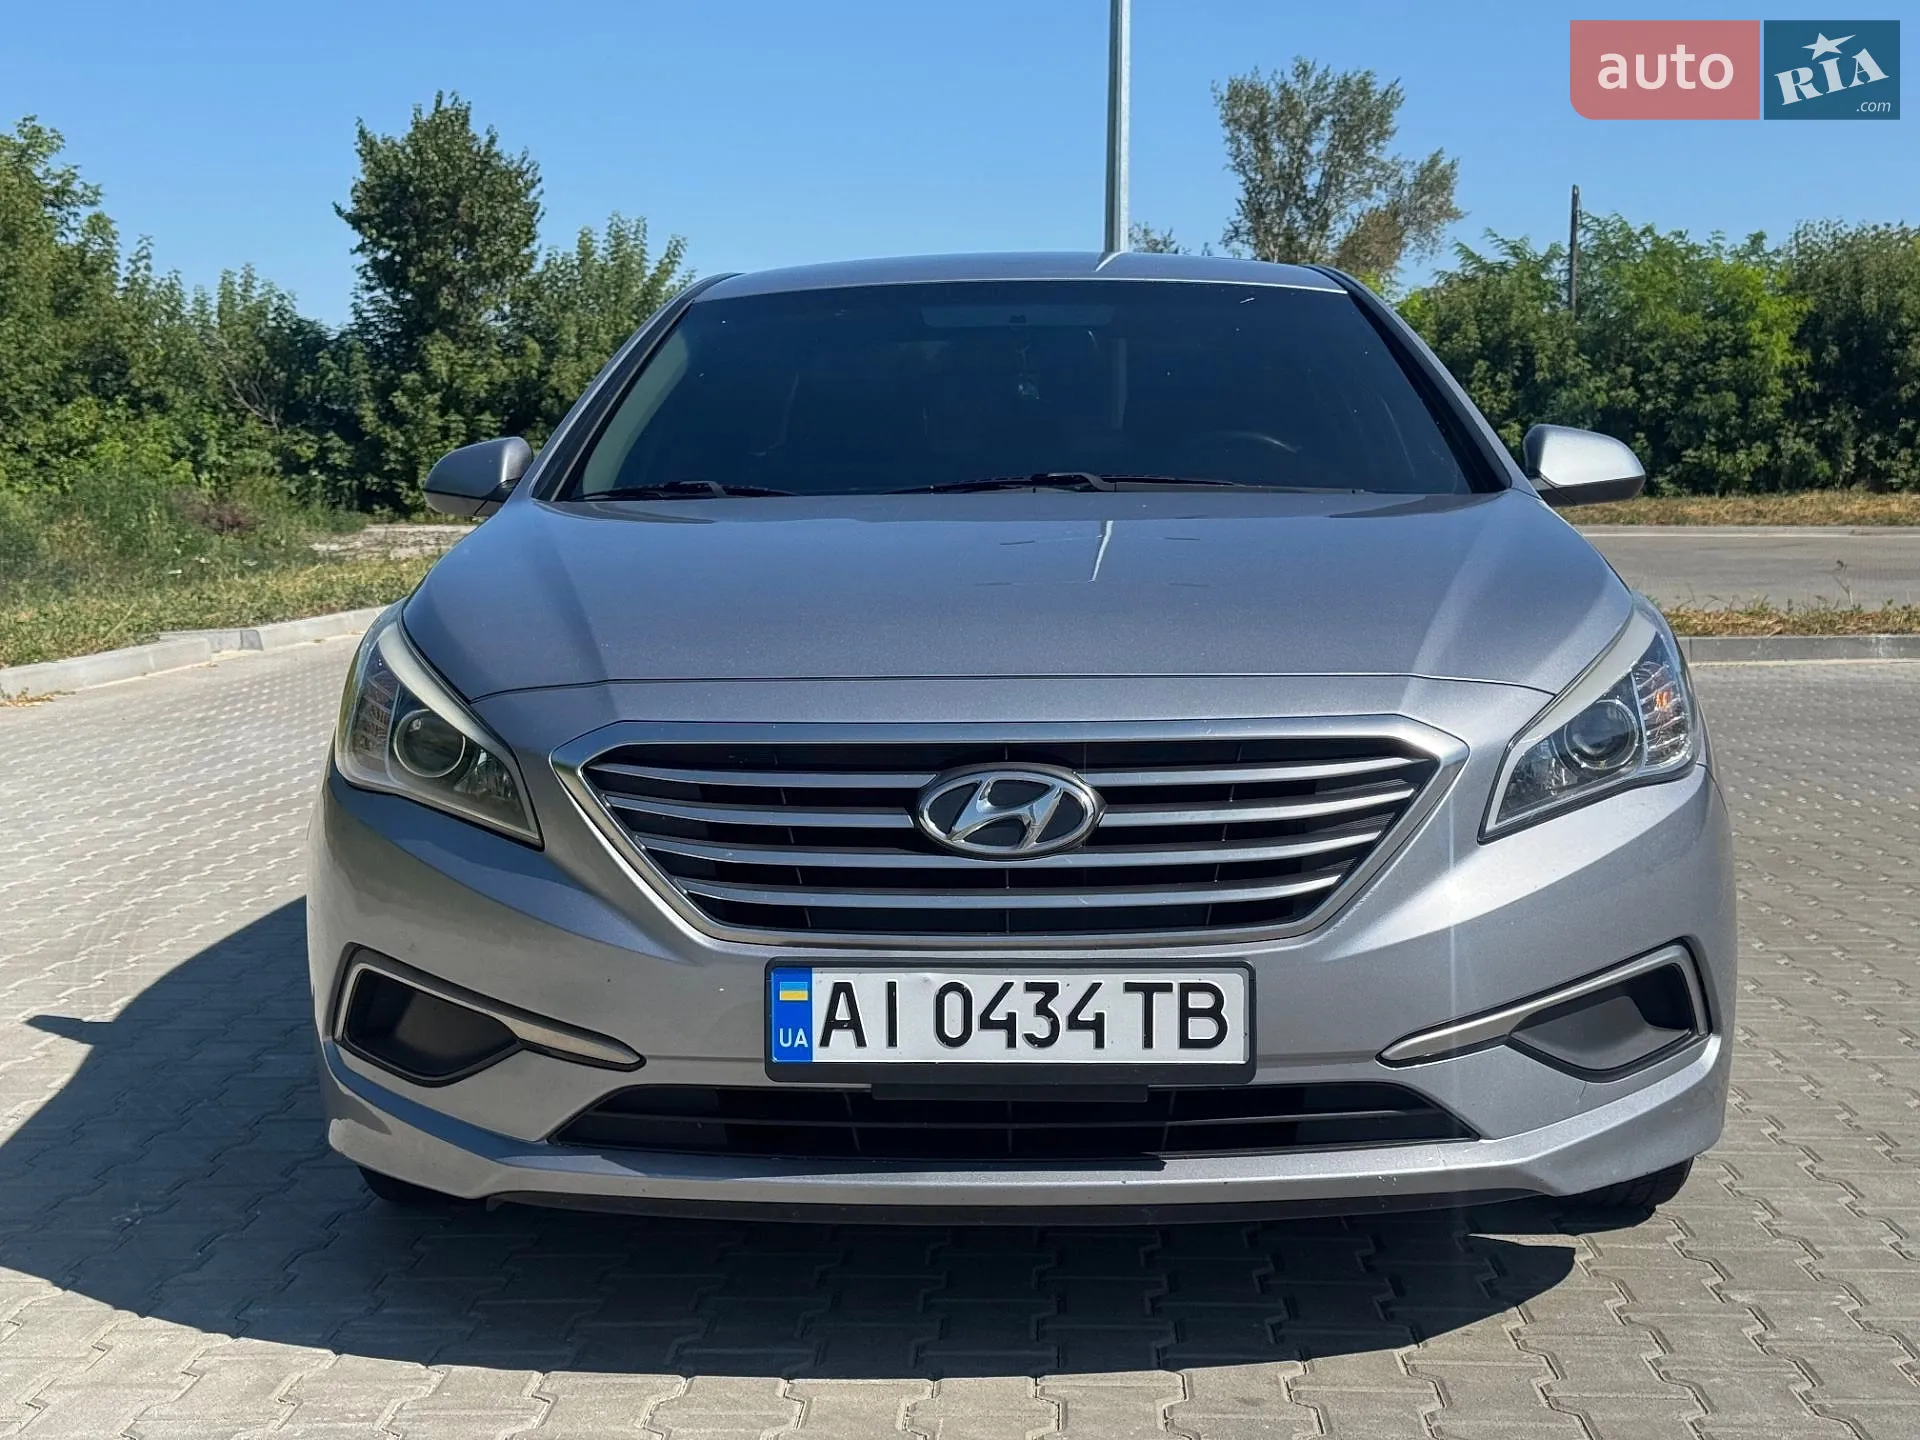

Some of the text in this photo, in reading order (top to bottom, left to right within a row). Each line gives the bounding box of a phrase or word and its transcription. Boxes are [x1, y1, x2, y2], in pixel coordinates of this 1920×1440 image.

[779, 1027, 809, 1049] UA
[819, 981, 1229, 1050] AI 0434 TB
